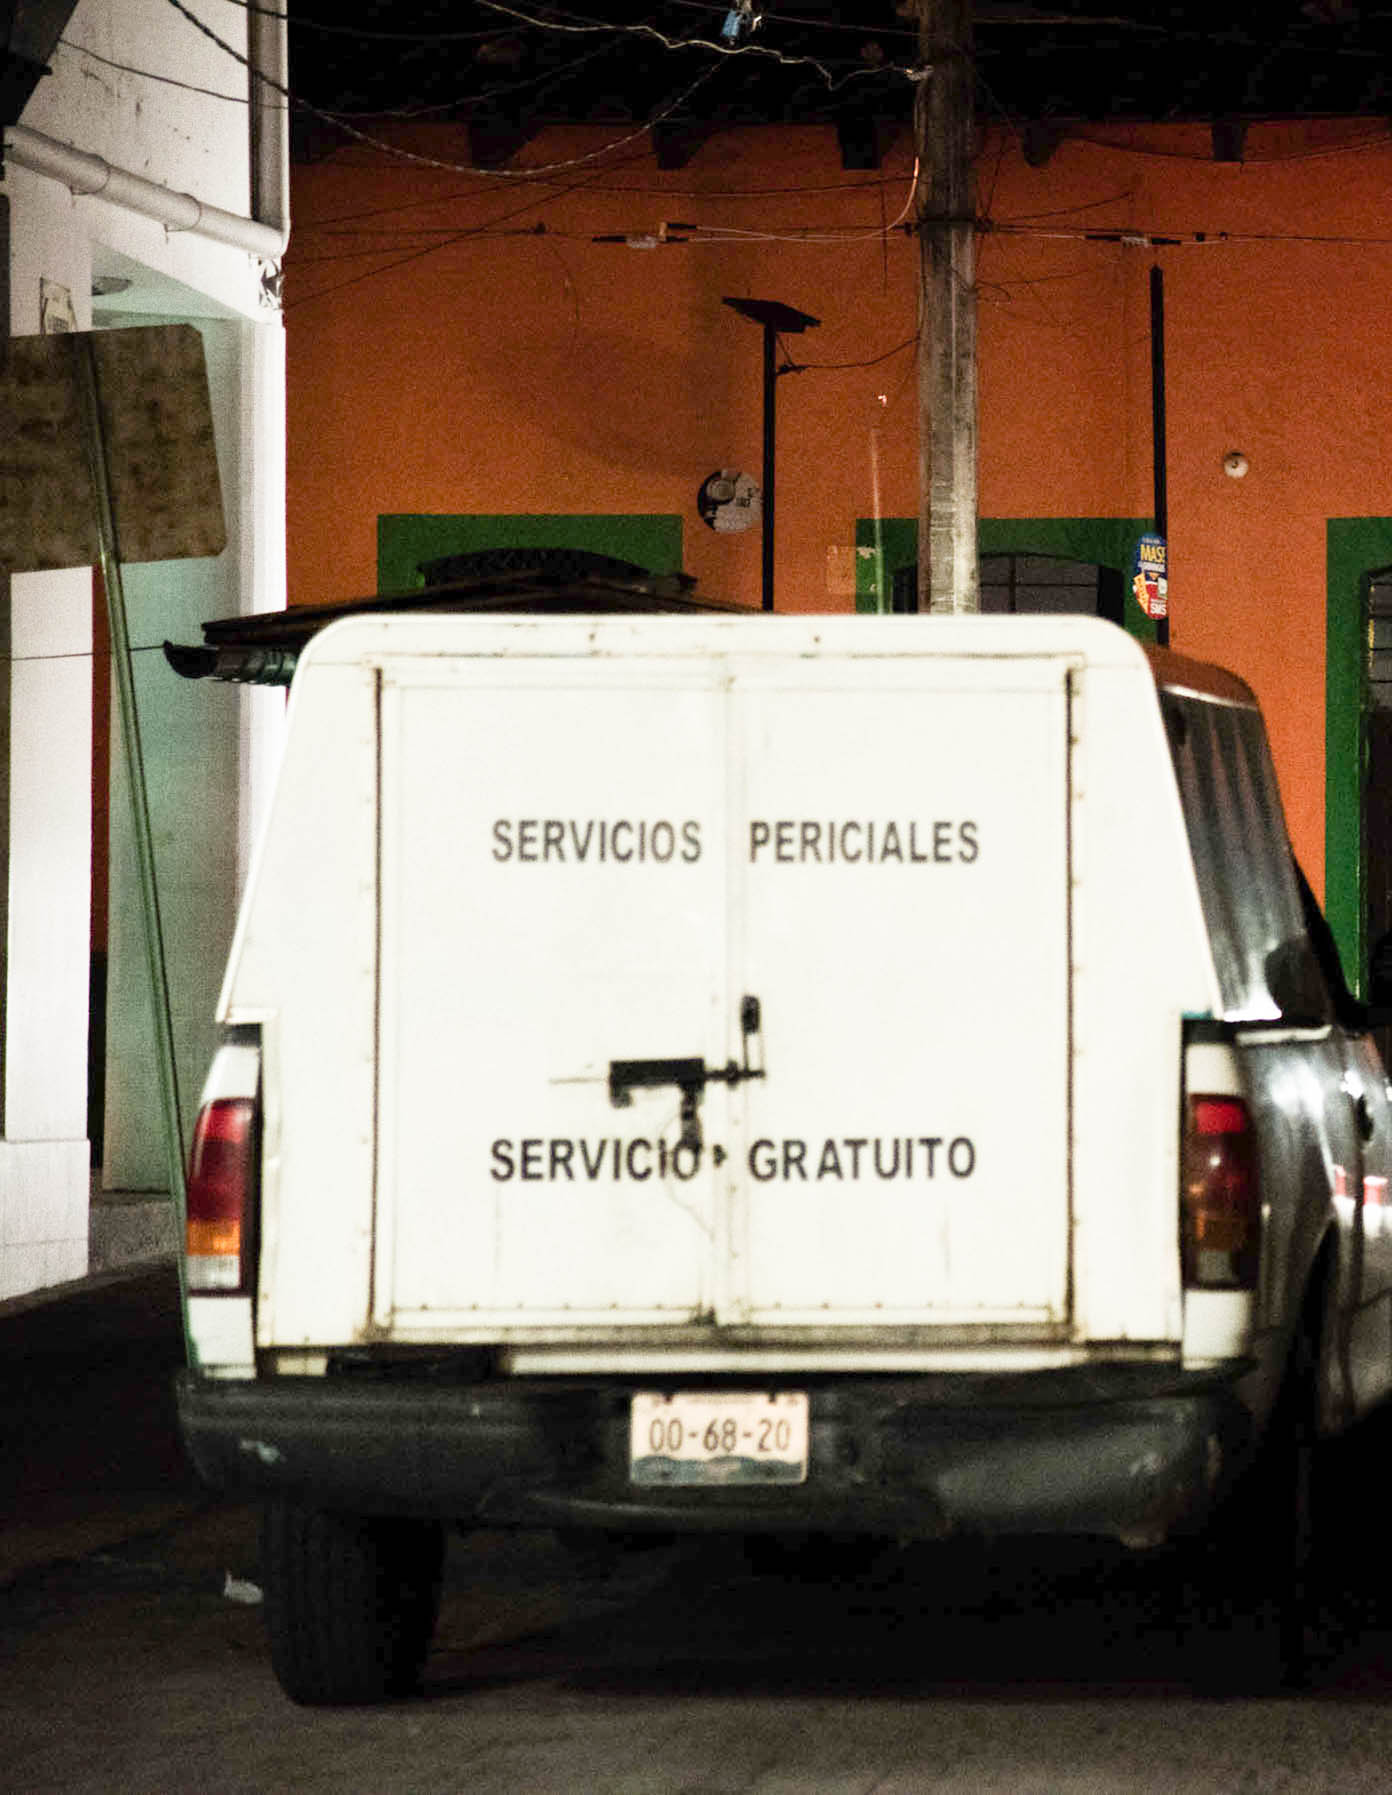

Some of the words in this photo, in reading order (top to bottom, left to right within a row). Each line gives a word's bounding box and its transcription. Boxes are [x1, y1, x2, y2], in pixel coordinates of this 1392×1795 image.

[492, 818, 702, 864] SERVICIOS
[749, 819, 980, 865] PERICIALES
[490, 1137, 701, 1183] SERVICIO
[747, 1136, 978, 1183] GRATUITO
[649, 1417, 791, 1453] 00-68-20
